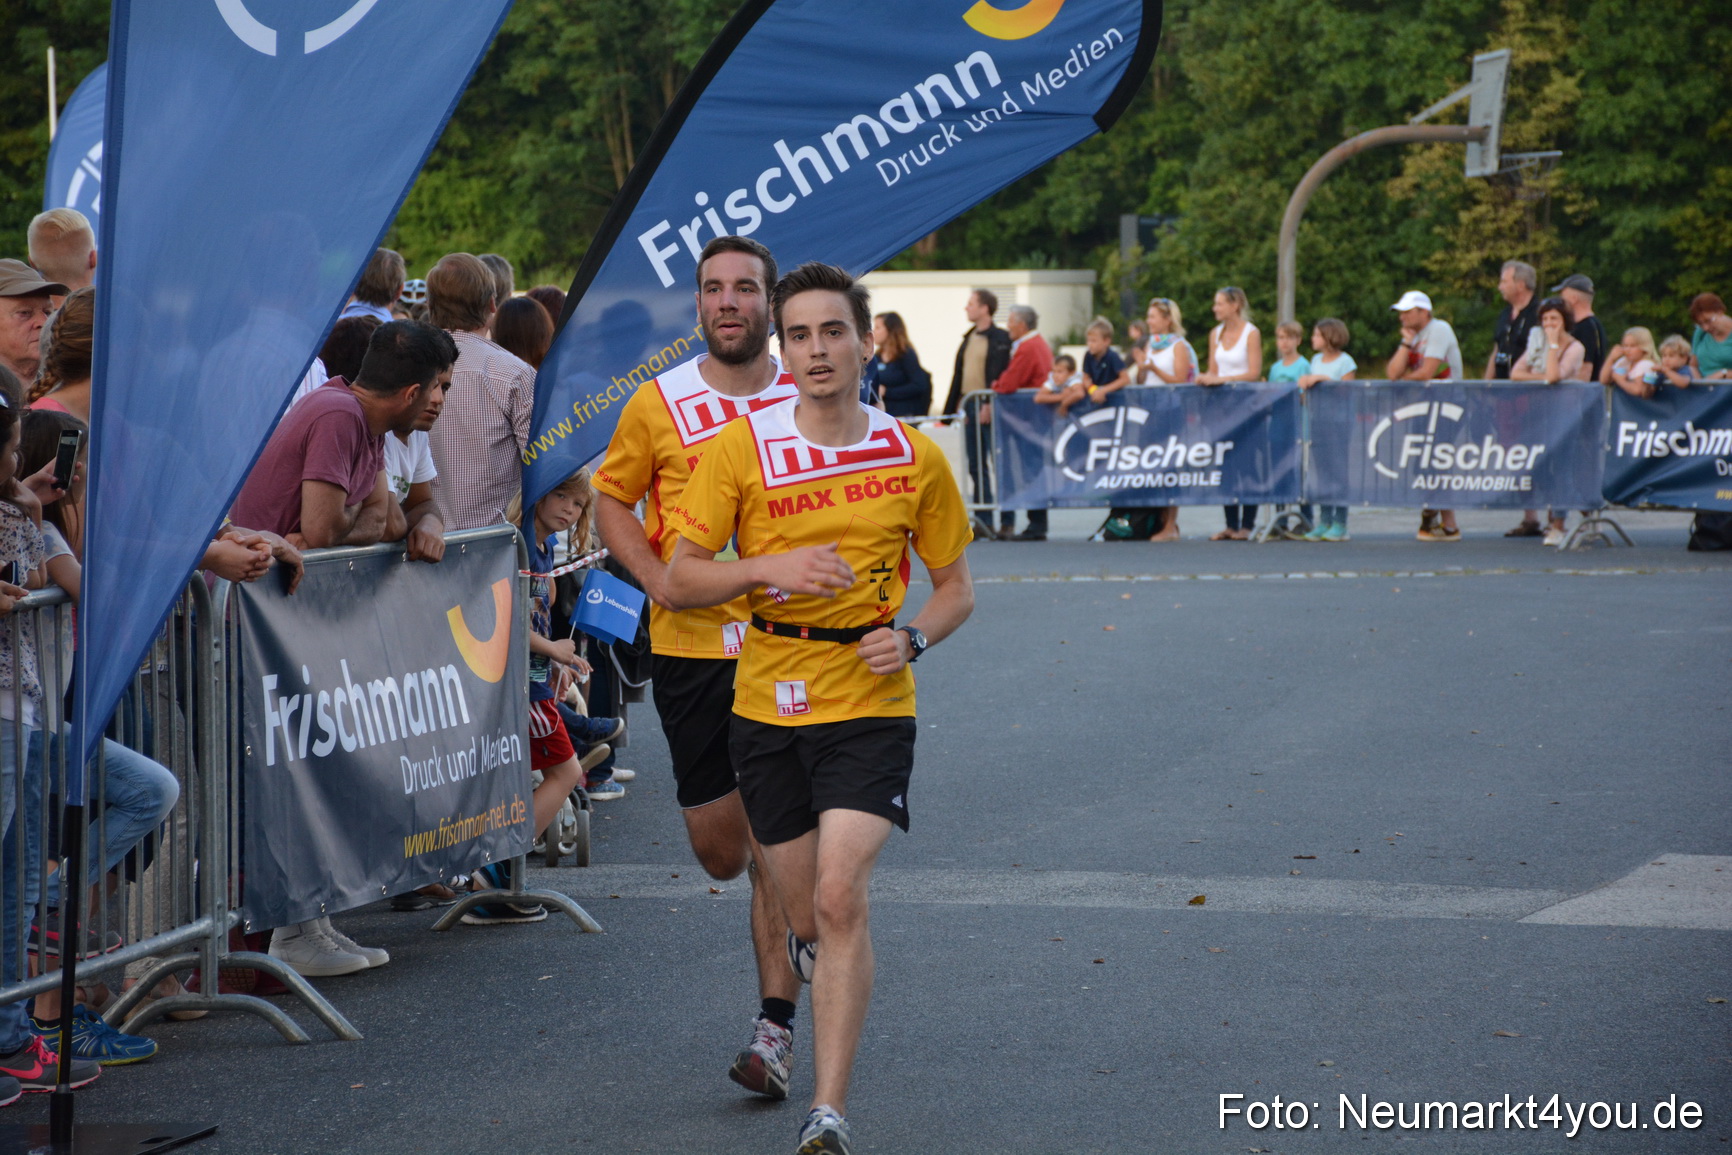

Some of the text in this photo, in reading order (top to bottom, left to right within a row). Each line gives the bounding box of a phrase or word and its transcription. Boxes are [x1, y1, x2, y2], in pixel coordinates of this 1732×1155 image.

[875, 27, 1124, 187] Druck und Medien
[637, 50, 1002, 289] Frischmann
[1085, 434, 1234, 472] Fischer
[1399, 434, 1546, 472] Fischer
[1616, 420, 1732, 458] Frischm
[767, 475, 917, 519] MAX BÖGL
[1093, 471, 1223, 489] AUTOMOBILE
[1411, 474, 1533, 492] AUTOMOBILE
[604, 595, 639, 619] Lebenshilfe
[262, 658, 471, 767] Frischmann
[400, 746, 446, 795] Druck
[447, 736, 477, 783] und
